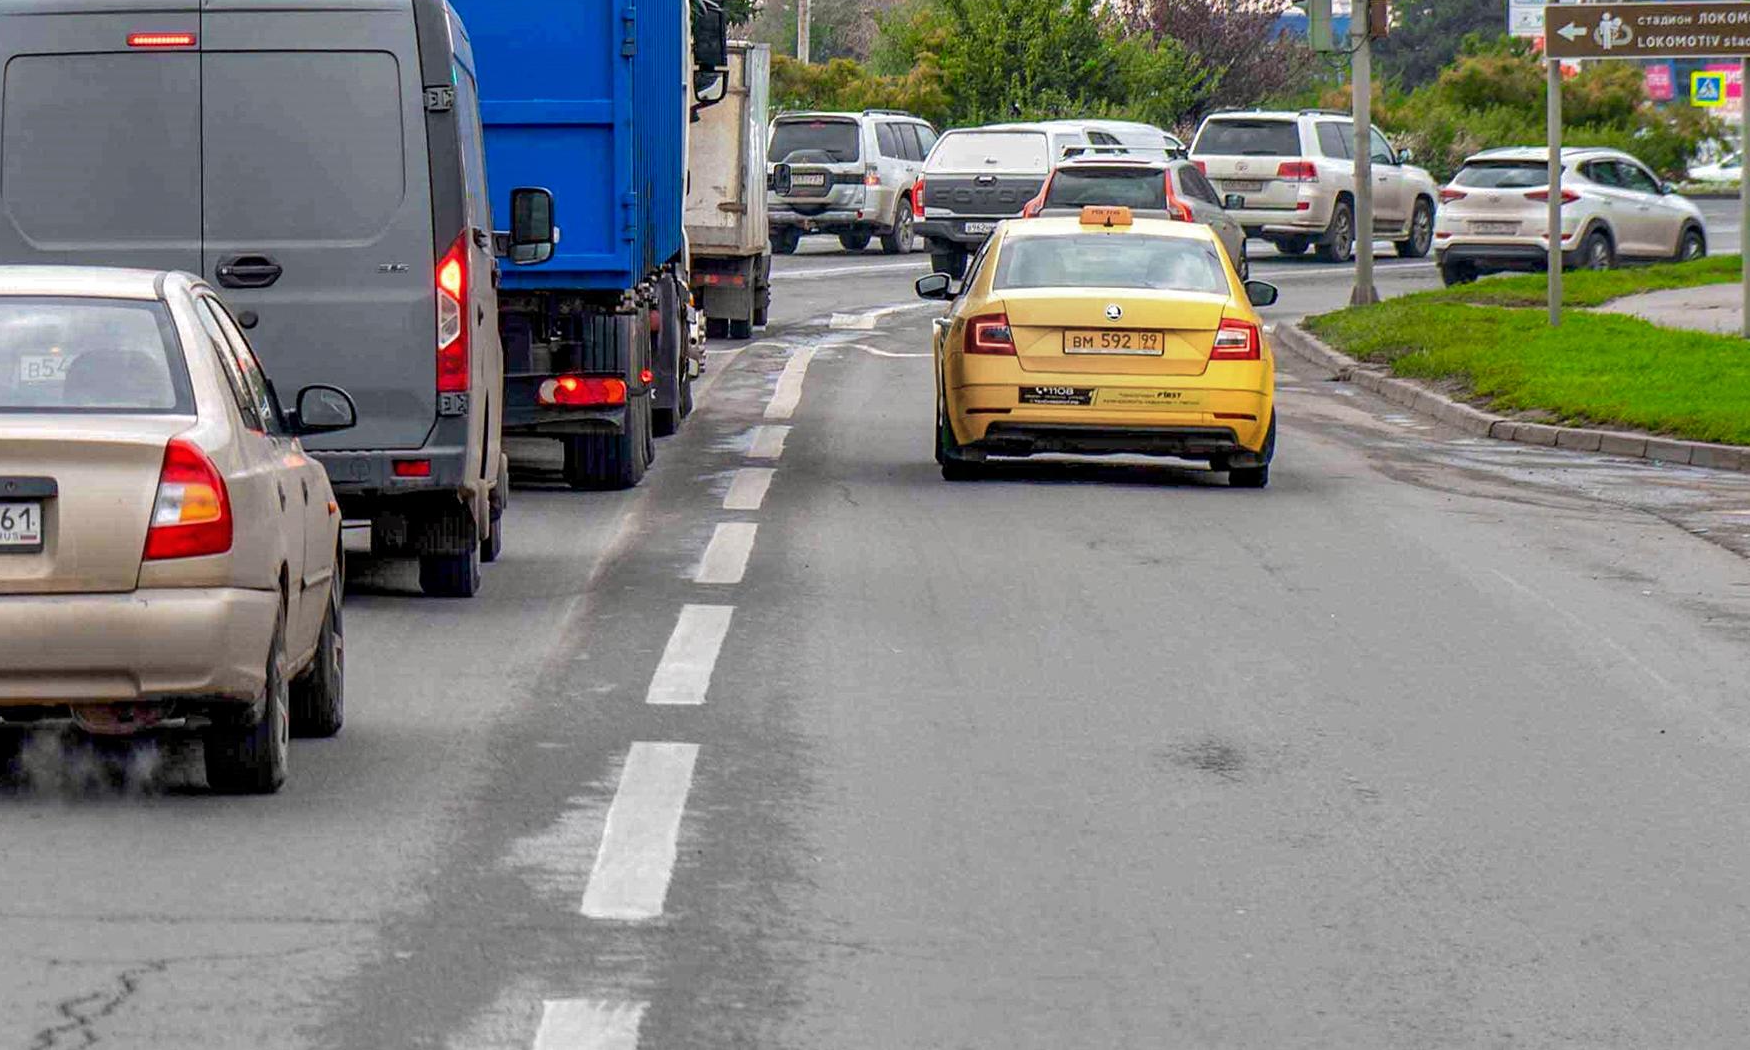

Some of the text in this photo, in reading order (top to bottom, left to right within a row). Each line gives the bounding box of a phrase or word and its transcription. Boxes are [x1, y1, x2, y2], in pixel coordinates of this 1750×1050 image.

[1637, 11, 1750, 26] стадион ЛОКОМ
[1637, 35, 1721, 48] LOKOMOTIV
[1073, 333, 1157, 349] ВМ 592 99
